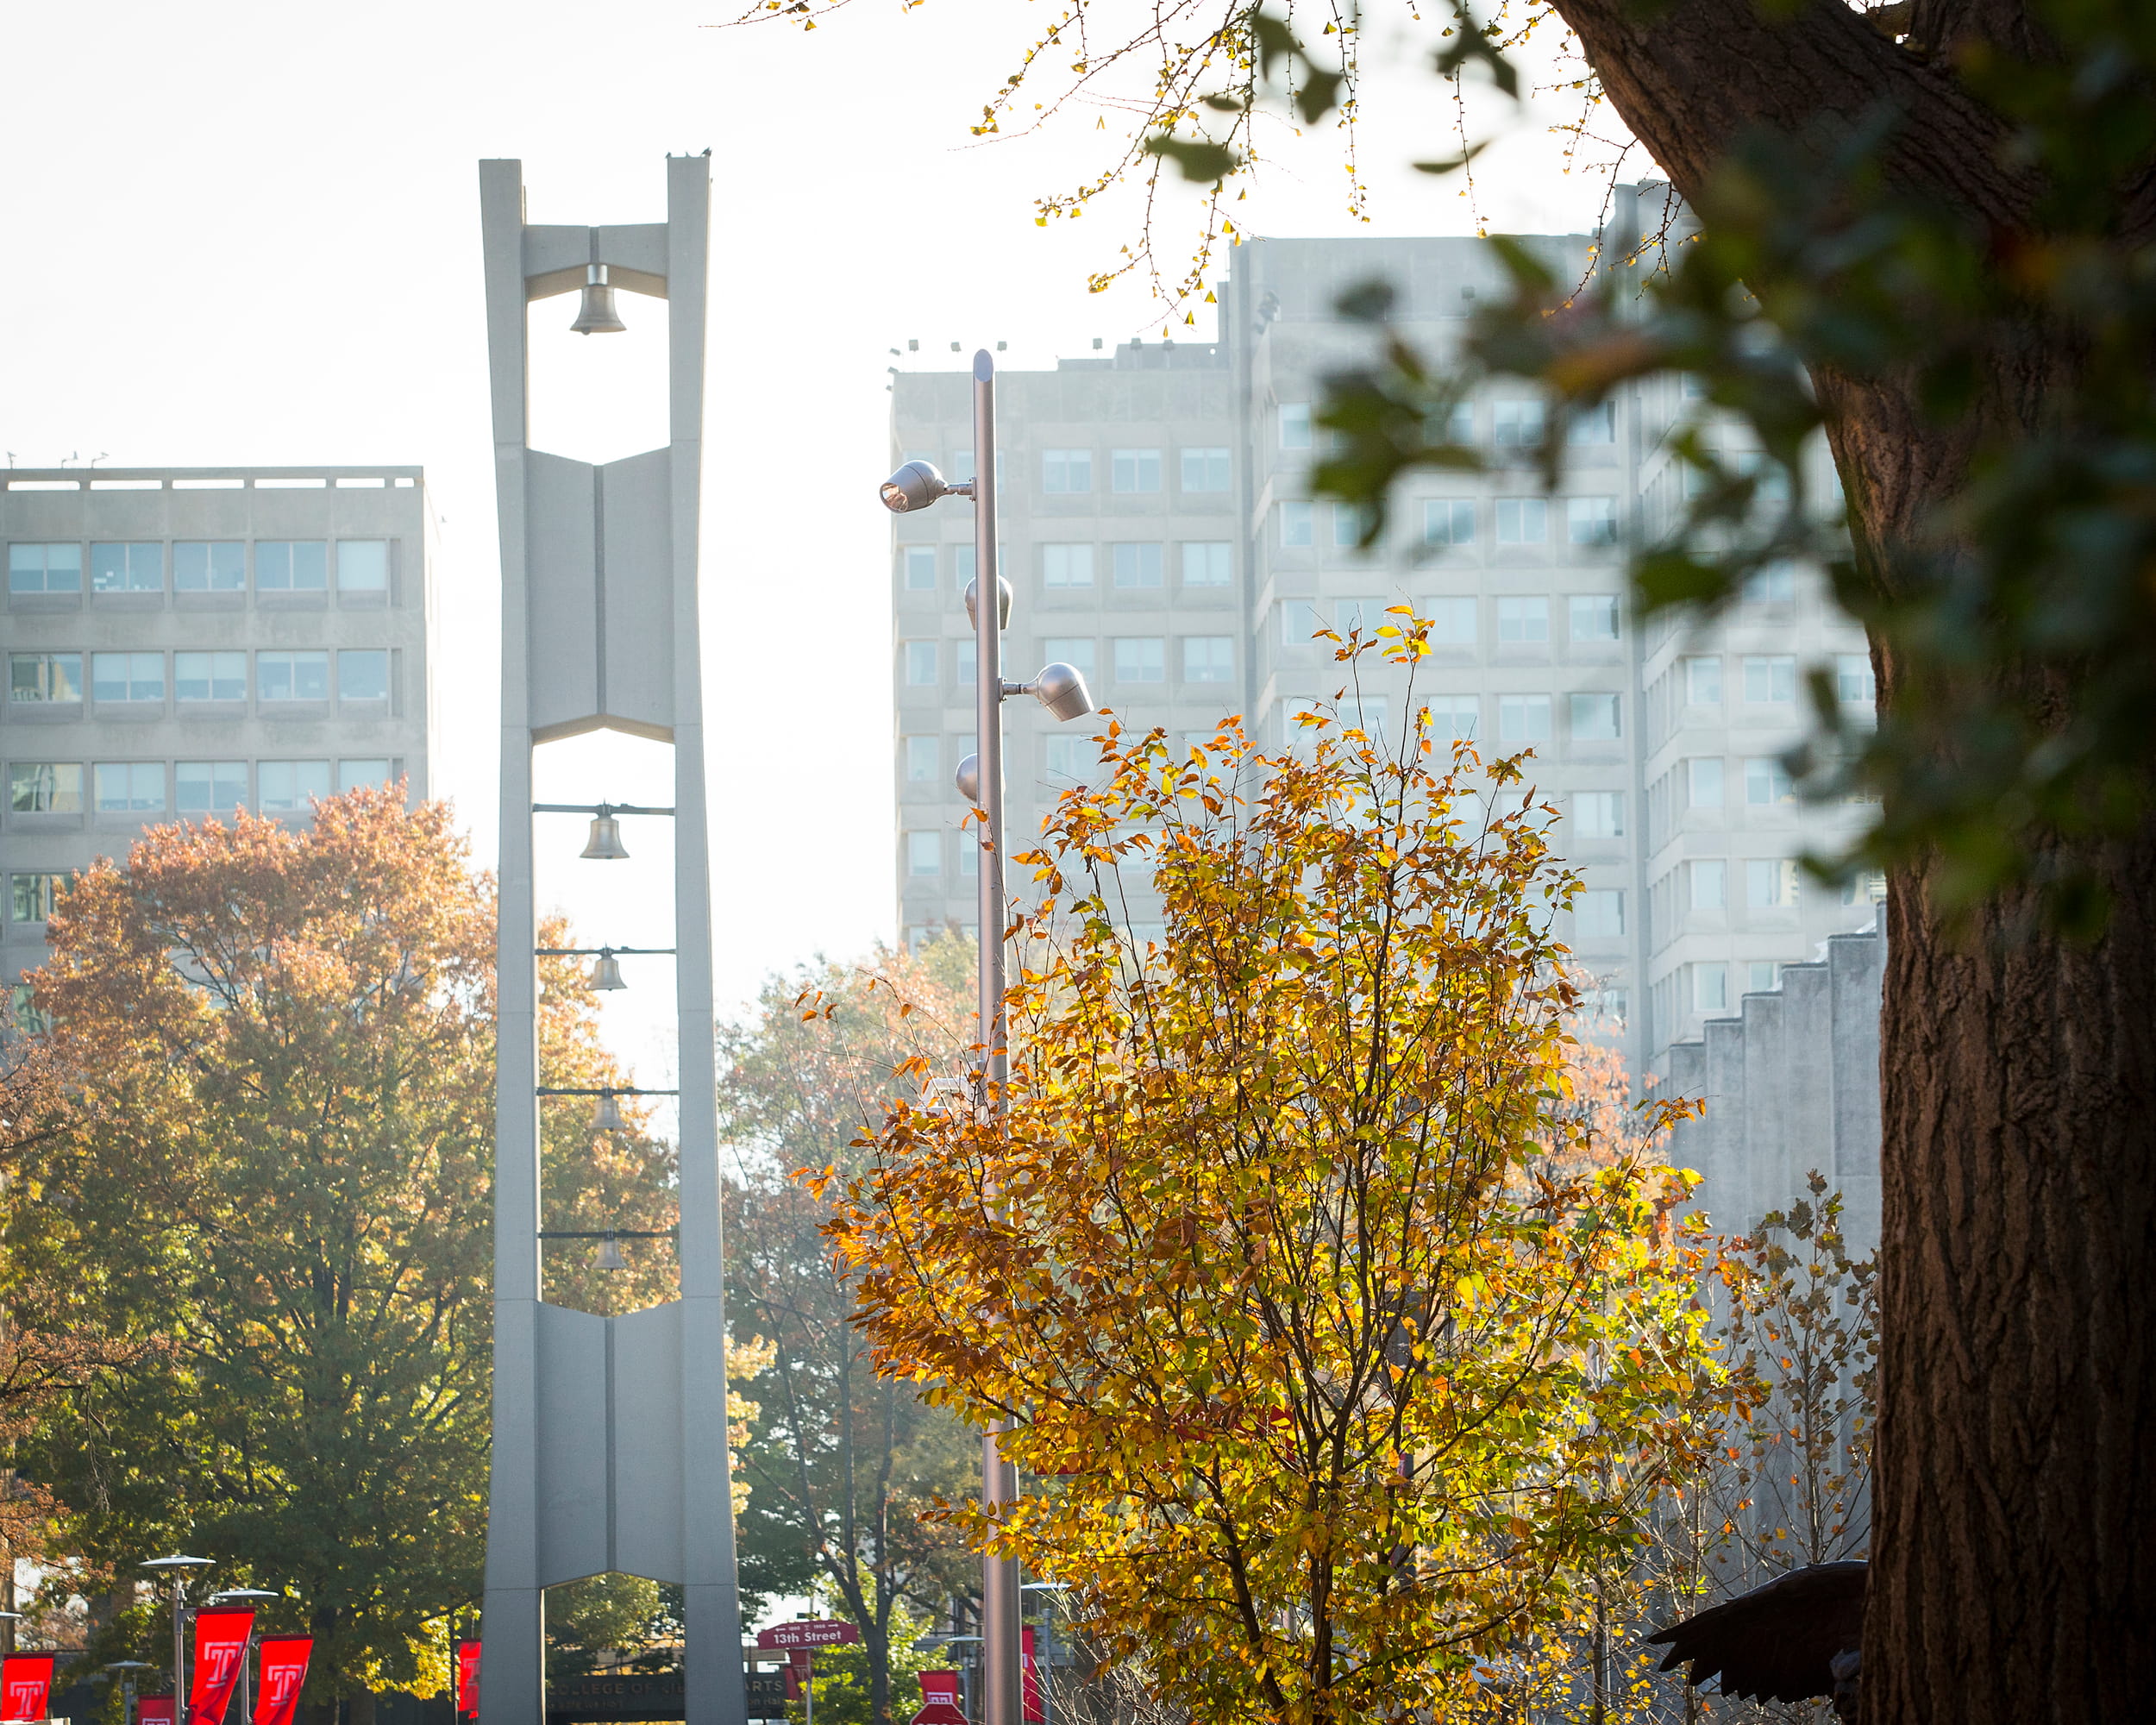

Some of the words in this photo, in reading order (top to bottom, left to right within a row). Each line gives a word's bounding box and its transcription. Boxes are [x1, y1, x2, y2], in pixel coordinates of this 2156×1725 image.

[774, 1633, 799, 1645] 13th
[805, 1630, 842, 1642] Street
[204, 1641, 244, 1689] T
[10, 1681, 45, 1721] T
[267, 1665, 303, 1707] T
